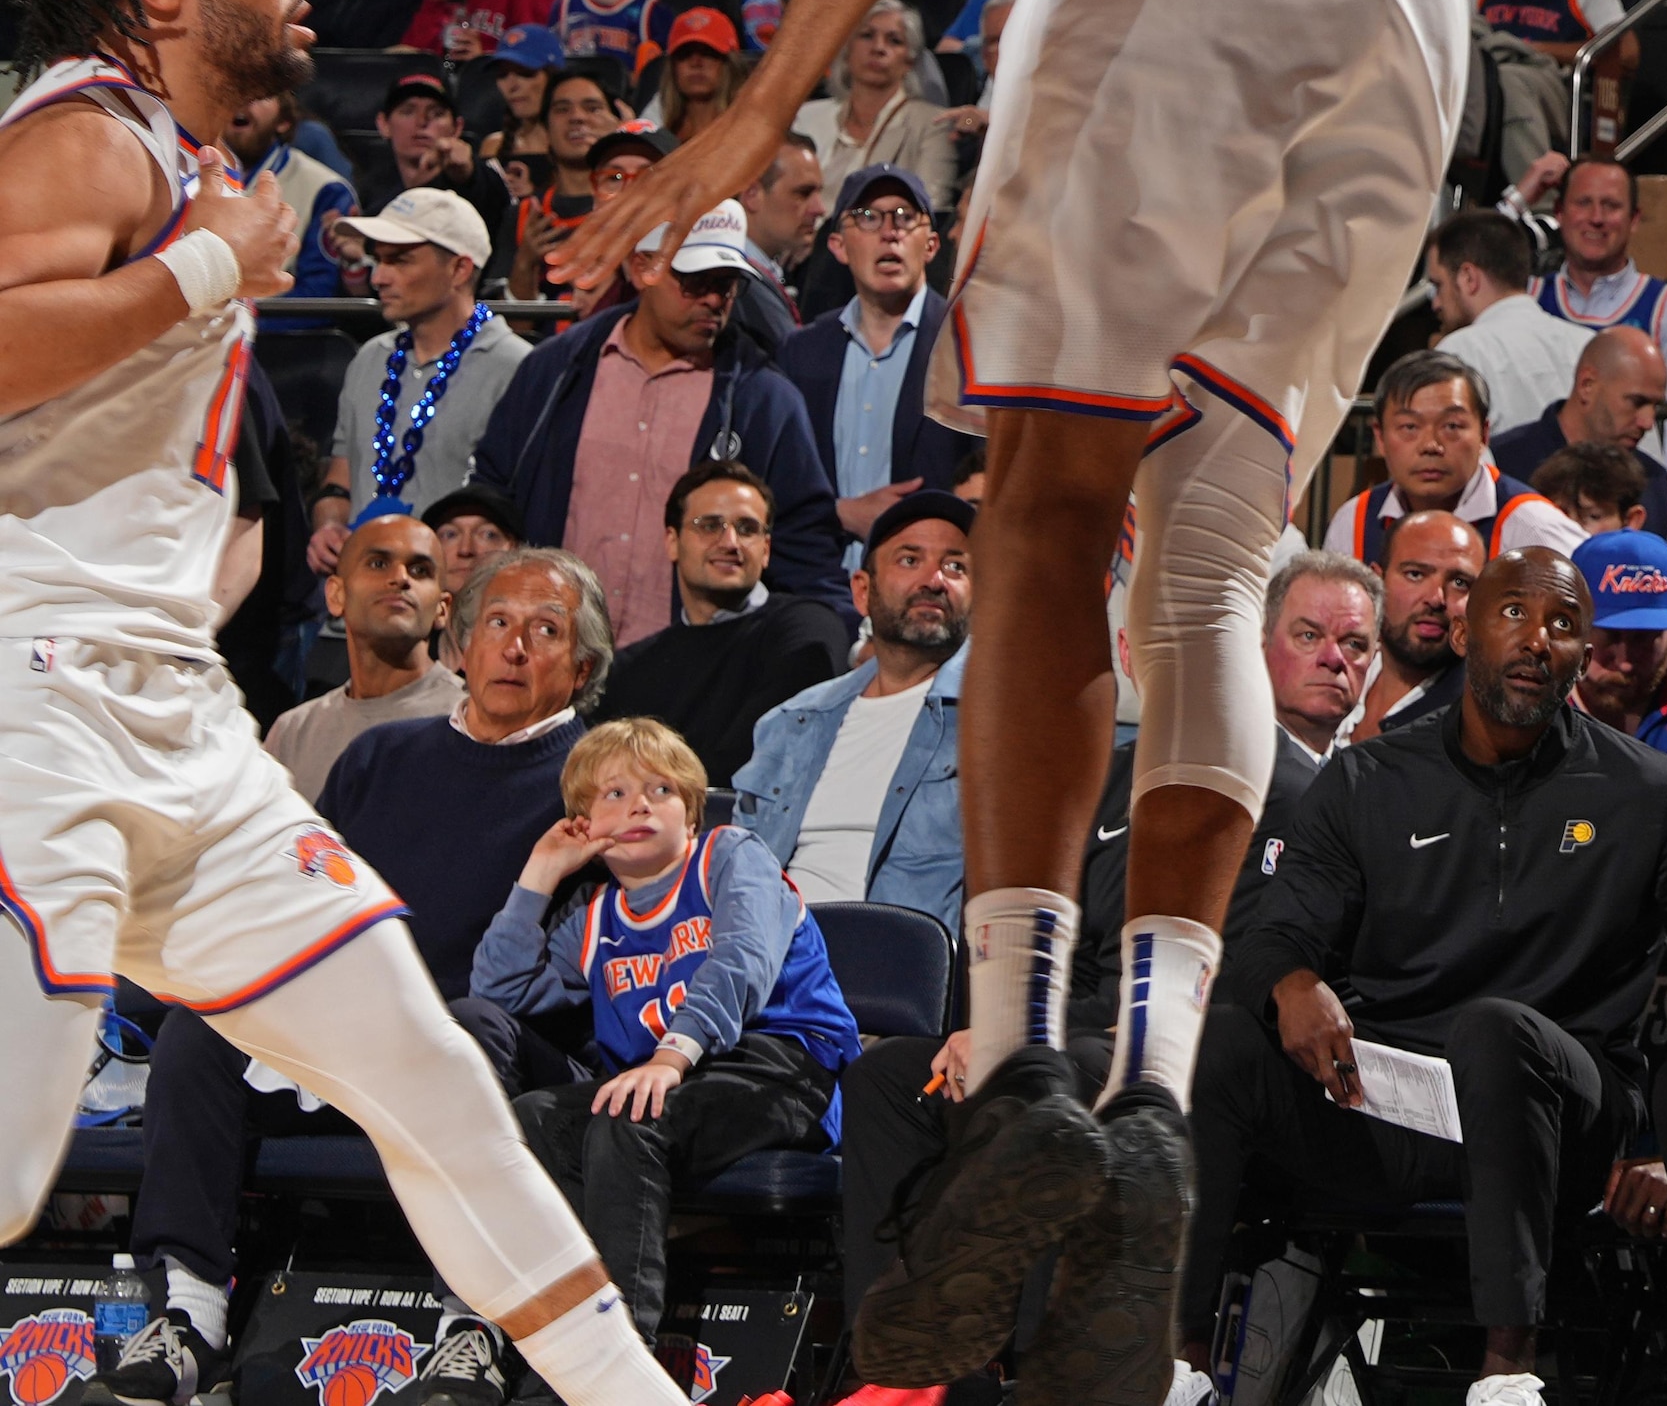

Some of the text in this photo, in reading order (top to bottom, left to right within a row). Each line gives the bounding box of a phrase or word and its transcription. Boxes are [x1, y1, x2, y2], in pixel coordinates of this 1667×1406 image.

[5, 1277, 44, 1295] SECTION
[70, 1280, 93, 1296] ROW
[314, 1287, 353, 1305] SECTION
[380, 1290, 404, 1308] ROW
[719, 1305, 744, 1321] SEAT
[0, 1321, 97, 1363] KNICKS
[302, 1331, 414, 1380] KNICKS
